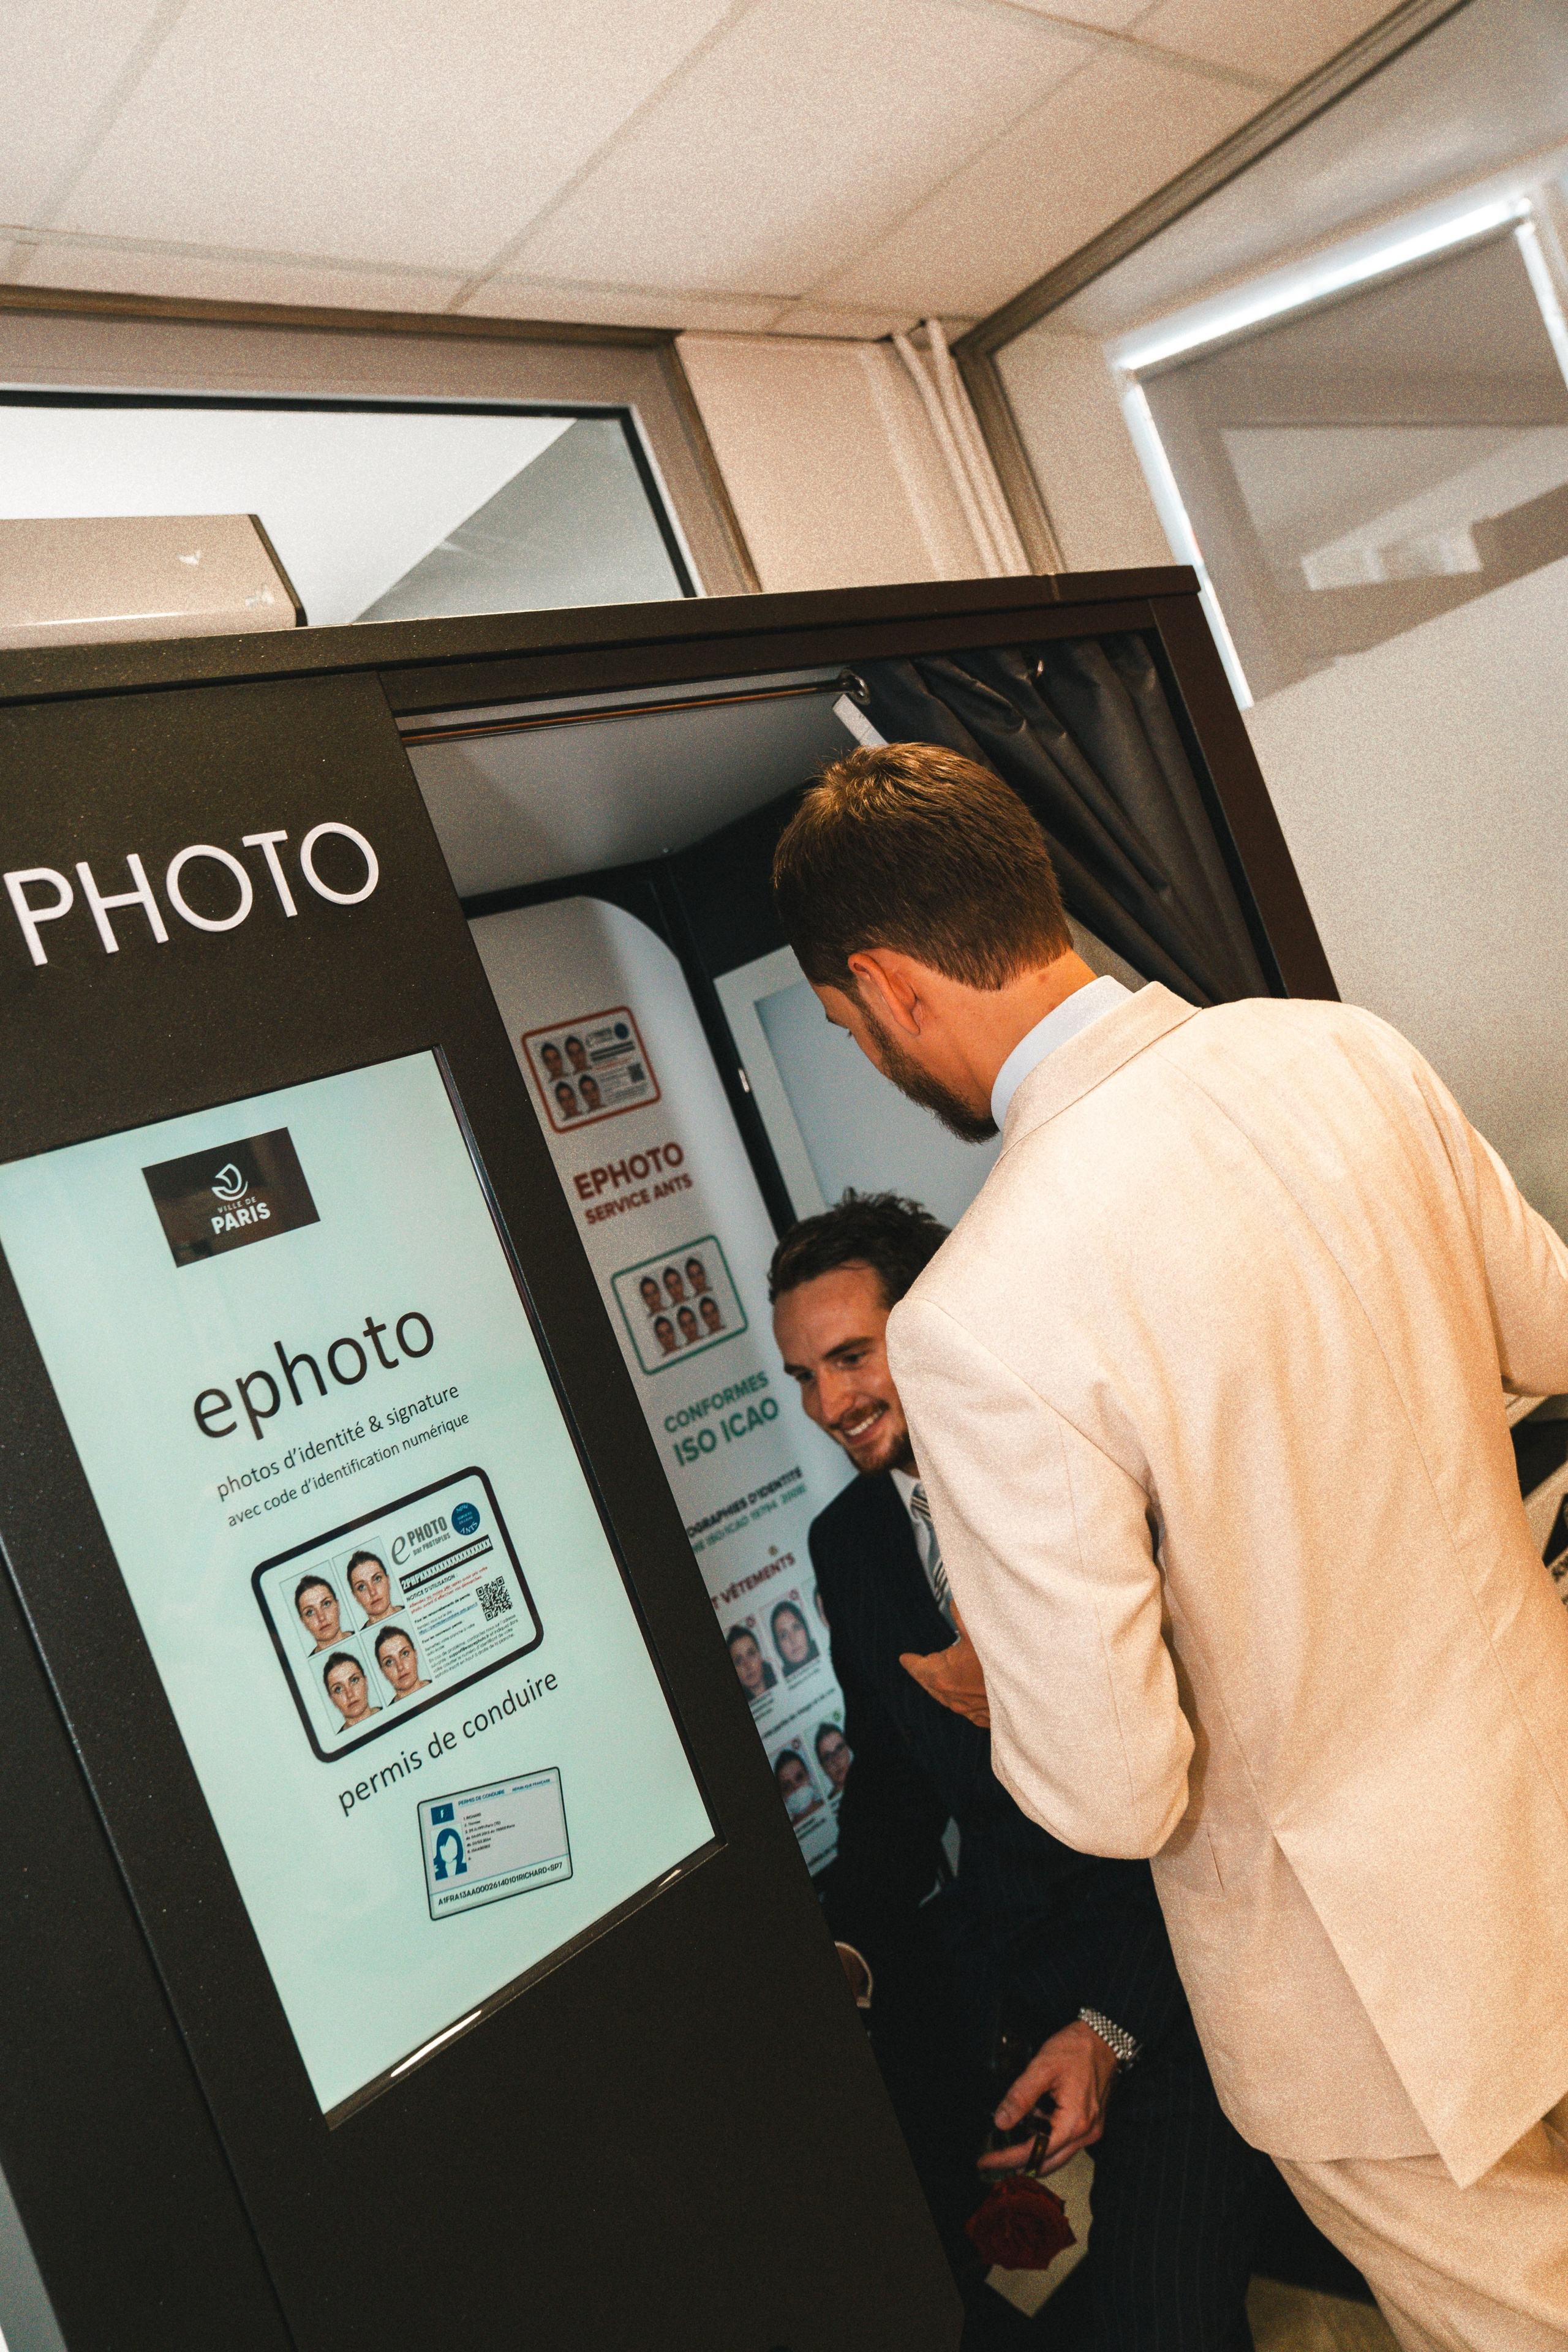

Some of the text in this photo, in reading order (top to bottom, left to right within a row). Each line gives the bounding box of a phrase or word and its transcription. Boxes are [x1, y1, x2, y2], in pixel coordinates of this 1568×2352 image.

[4, 821, 379, 966] PHOTO
[573, 1141, 685, 1200] EPHOTO
[211, 1202, 271, 1235] PARIS
[217, 1196, 257, 1213] VILLE DE
[585, 1172, 693, 1226] SERVICE ANTS
[194, 1311, 434, 1440] ephoto
[663, 1370, 771, 1434] CONFORMES
[216, 1384, 460, 1501] photos d'identité & signature
[673, 1397, 780, 1466] ISO ICAO
[228, 1412, 470, 1526] avec code d'identification numérique
[407, 1516, 448, 1546] PHOTO
[423, 1532, 451, 1550] PHOTOPLUS
[460, 1521, 477, 1534] ANTS
[406, 1589, 424, 1602] NOTICE
[424, 1574, 456, 1593] D'UTILISATION
[720, 1551, 796, 1604] VÊTEMENTS
[339, 1673, 559, 1817] permis de conduire
